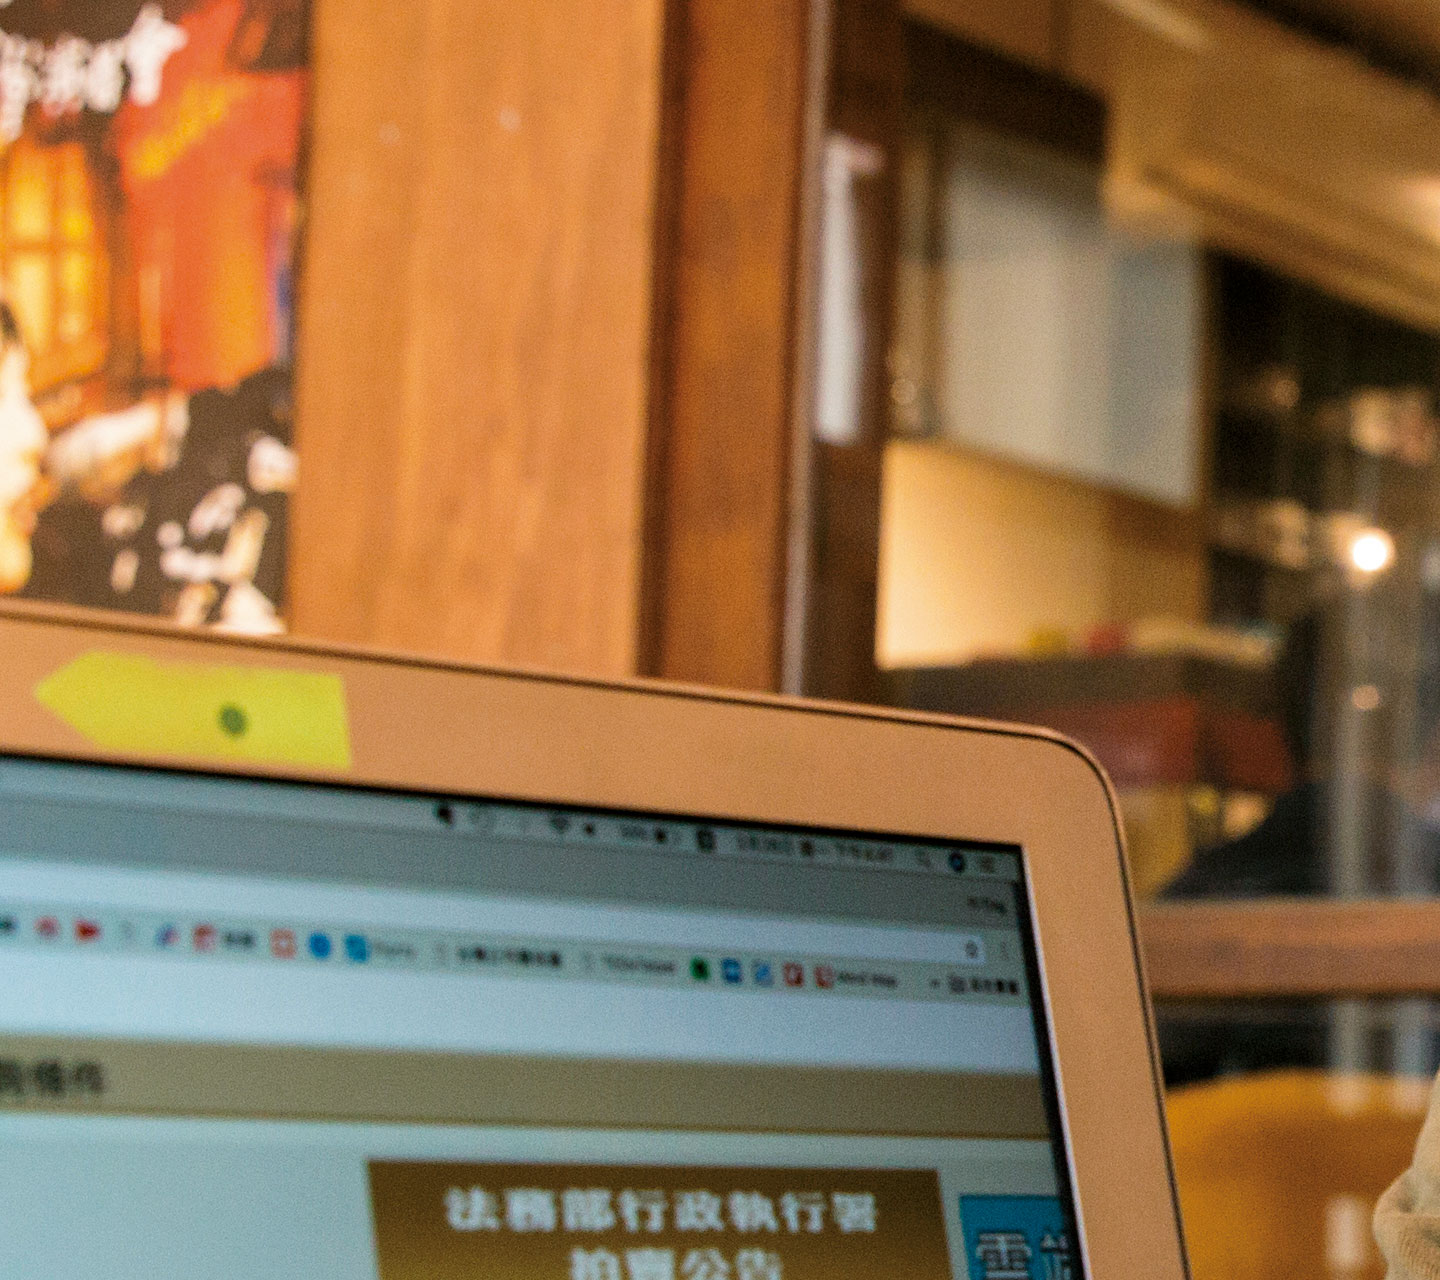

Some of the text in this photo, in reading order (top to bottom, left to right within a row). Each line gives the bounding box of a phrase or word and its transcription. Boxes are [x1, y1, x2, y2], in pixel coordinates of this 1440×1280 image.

[443, 1186, 878, 1233] 法務部行政執行署
